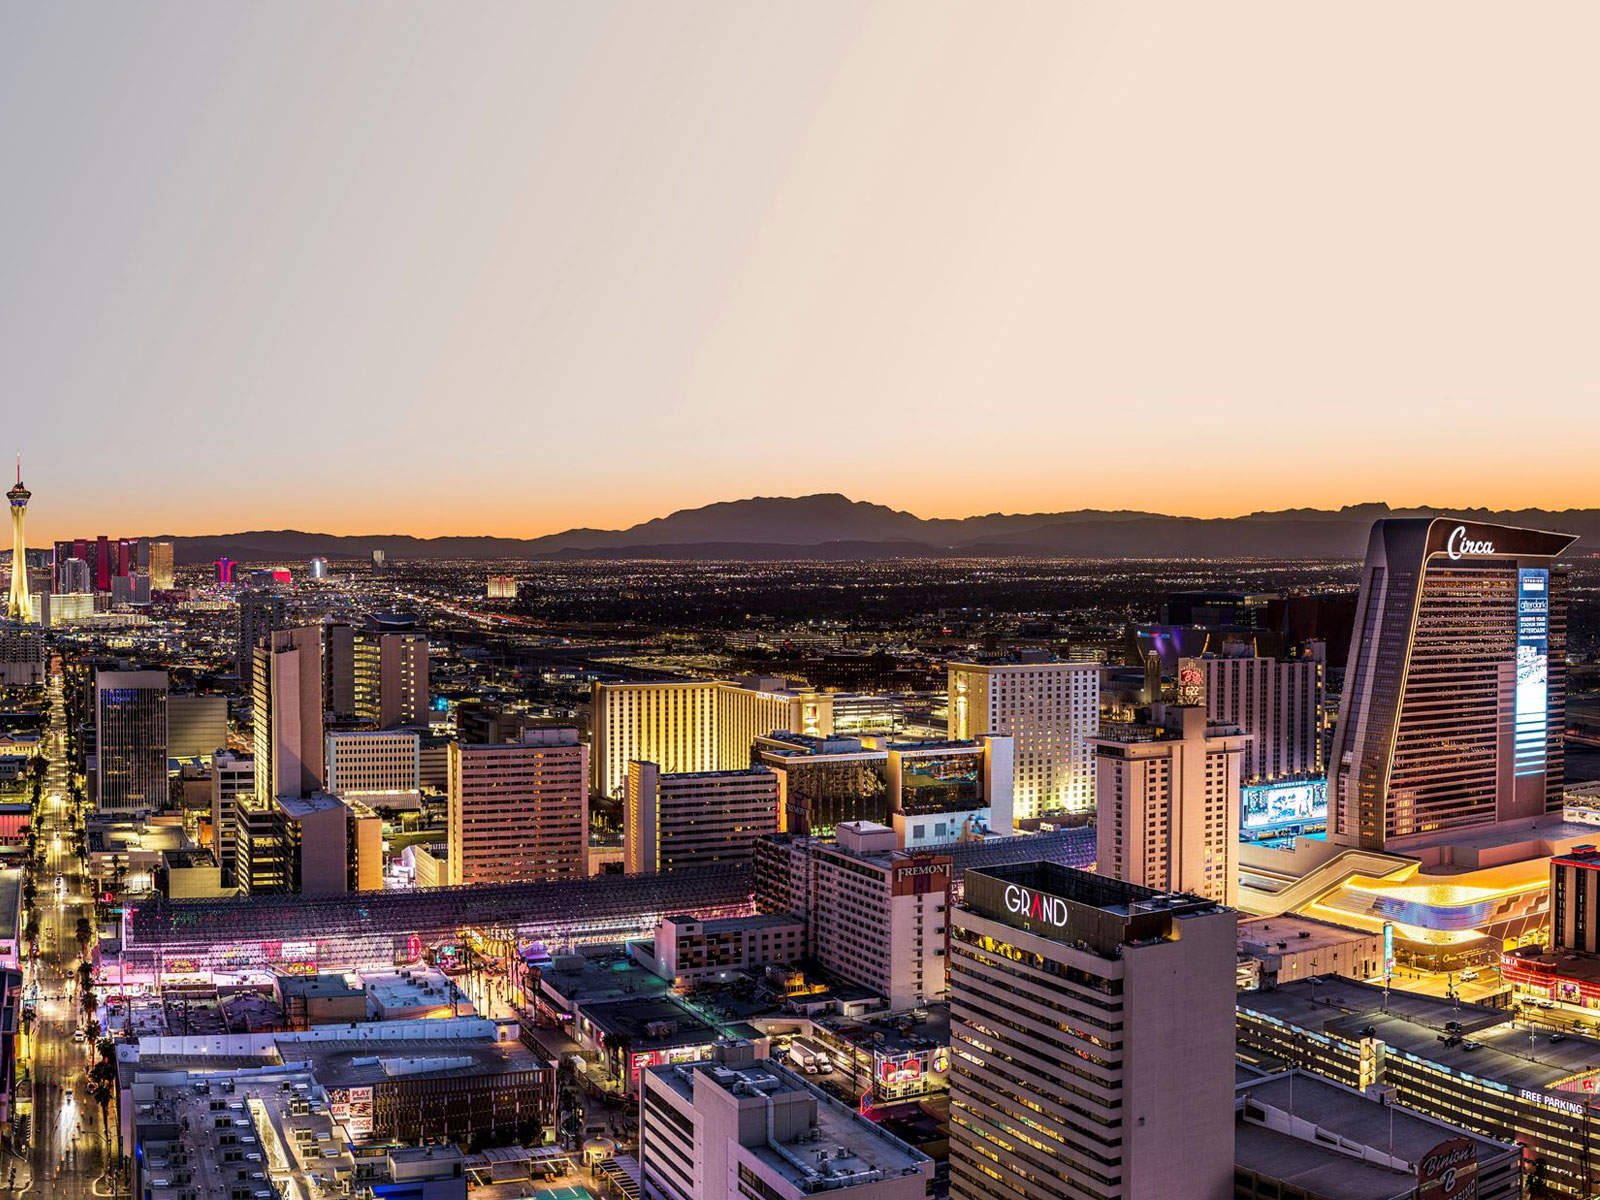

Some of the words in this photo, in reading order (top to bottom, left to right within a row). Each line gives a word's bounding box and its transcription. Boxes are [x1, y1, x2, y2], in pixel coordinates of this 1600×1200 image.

[1447, 525, 1495, 560] Circa
[897, 864, 952, 882] FREMONT
[1005, 884, 1068, 927] GRAND
[1521, 1089, 1542, 1104] FREE
[1543, 1096, 1583, 1114] PARKING
[1423, 1143, 1476, 1177] Binion's
